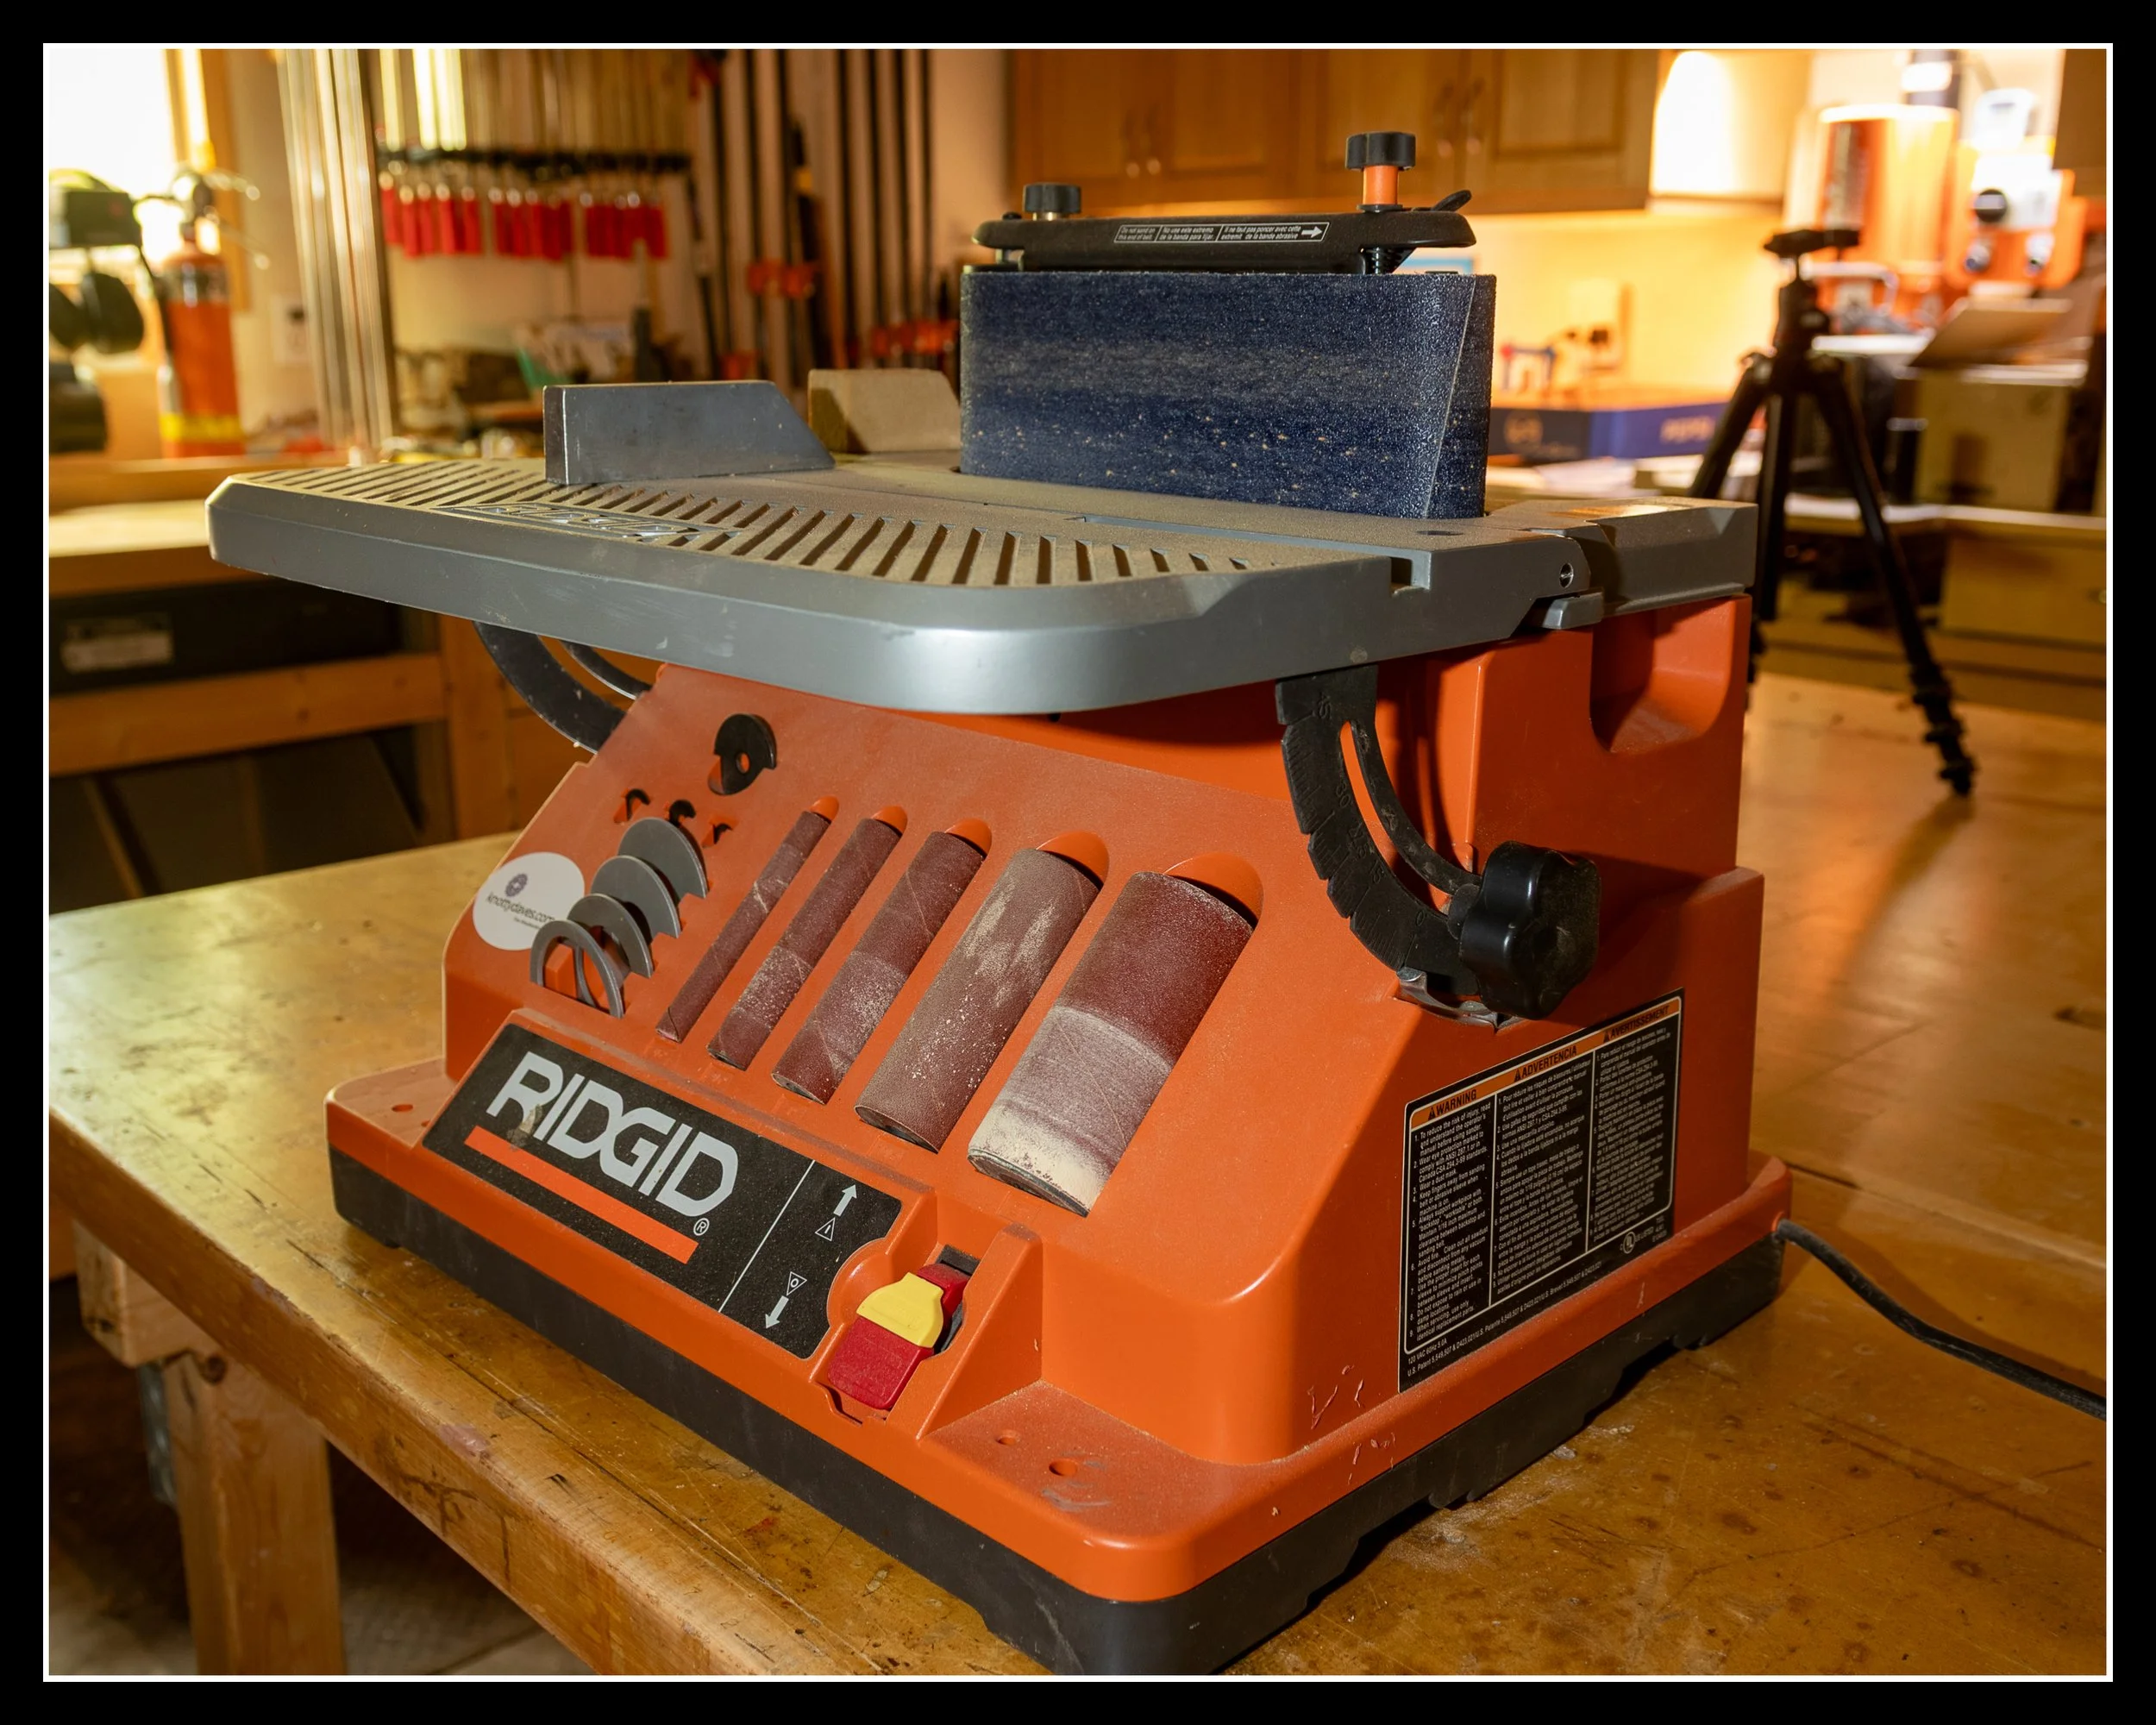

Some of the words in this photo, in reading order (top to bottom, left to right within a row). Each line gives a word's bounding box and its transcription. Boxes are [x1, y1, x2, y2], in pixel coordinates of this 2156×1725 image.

[1610, 1004, 1668, 1039] AVERTISSEMENT
[1522, 1045, 1576, 1078] ADVERTENCIA
[1437, 1089, 1476, 1115] WARNING
[486, 1051, 738, 1217] RIDGID
